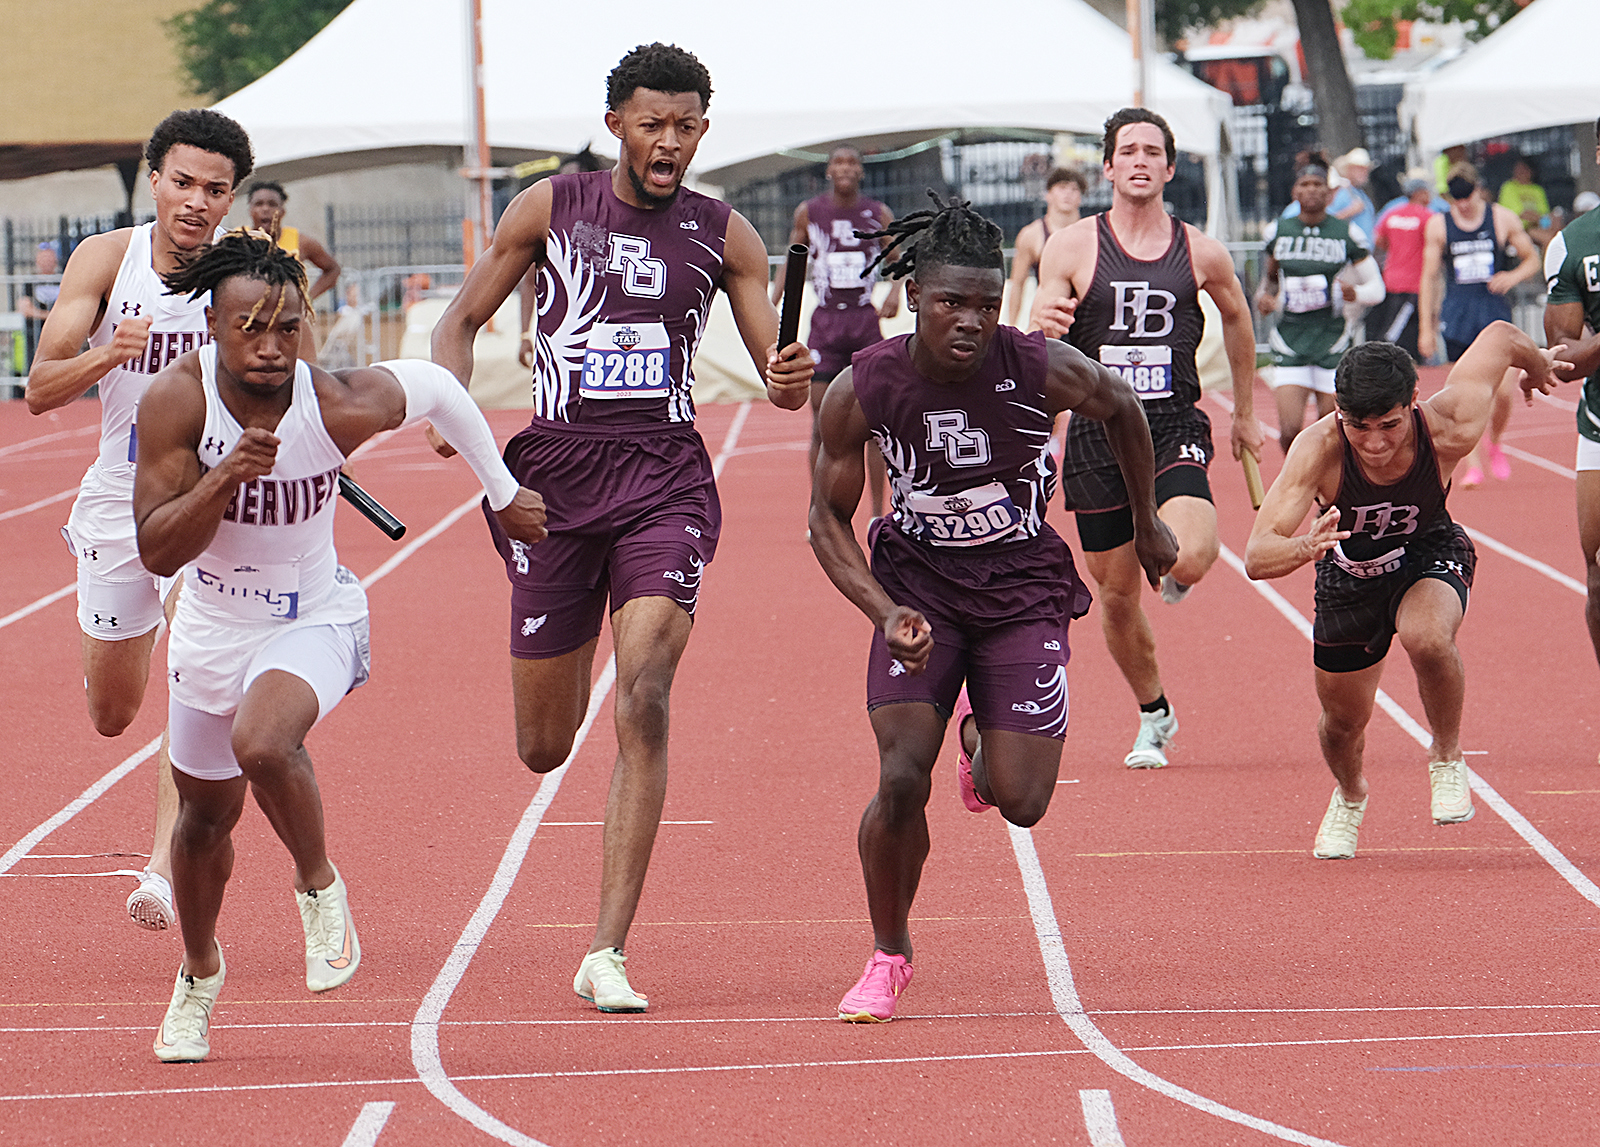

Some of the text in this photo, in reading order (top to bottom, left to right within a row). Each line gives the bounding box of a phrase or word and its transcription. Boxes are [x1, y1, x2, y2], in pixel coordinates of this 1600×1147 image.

[605, 232, 668, 300] RO
[1273, 235, 1347, 264] ELLISON
[1109, 281, 1177, 338] FB
[612, 335, 641, 344] STATE
[585, 351, 664, 387] 3288
[923, 408, 992, 469] RO
[925, 504, 1012, 540] 3290
